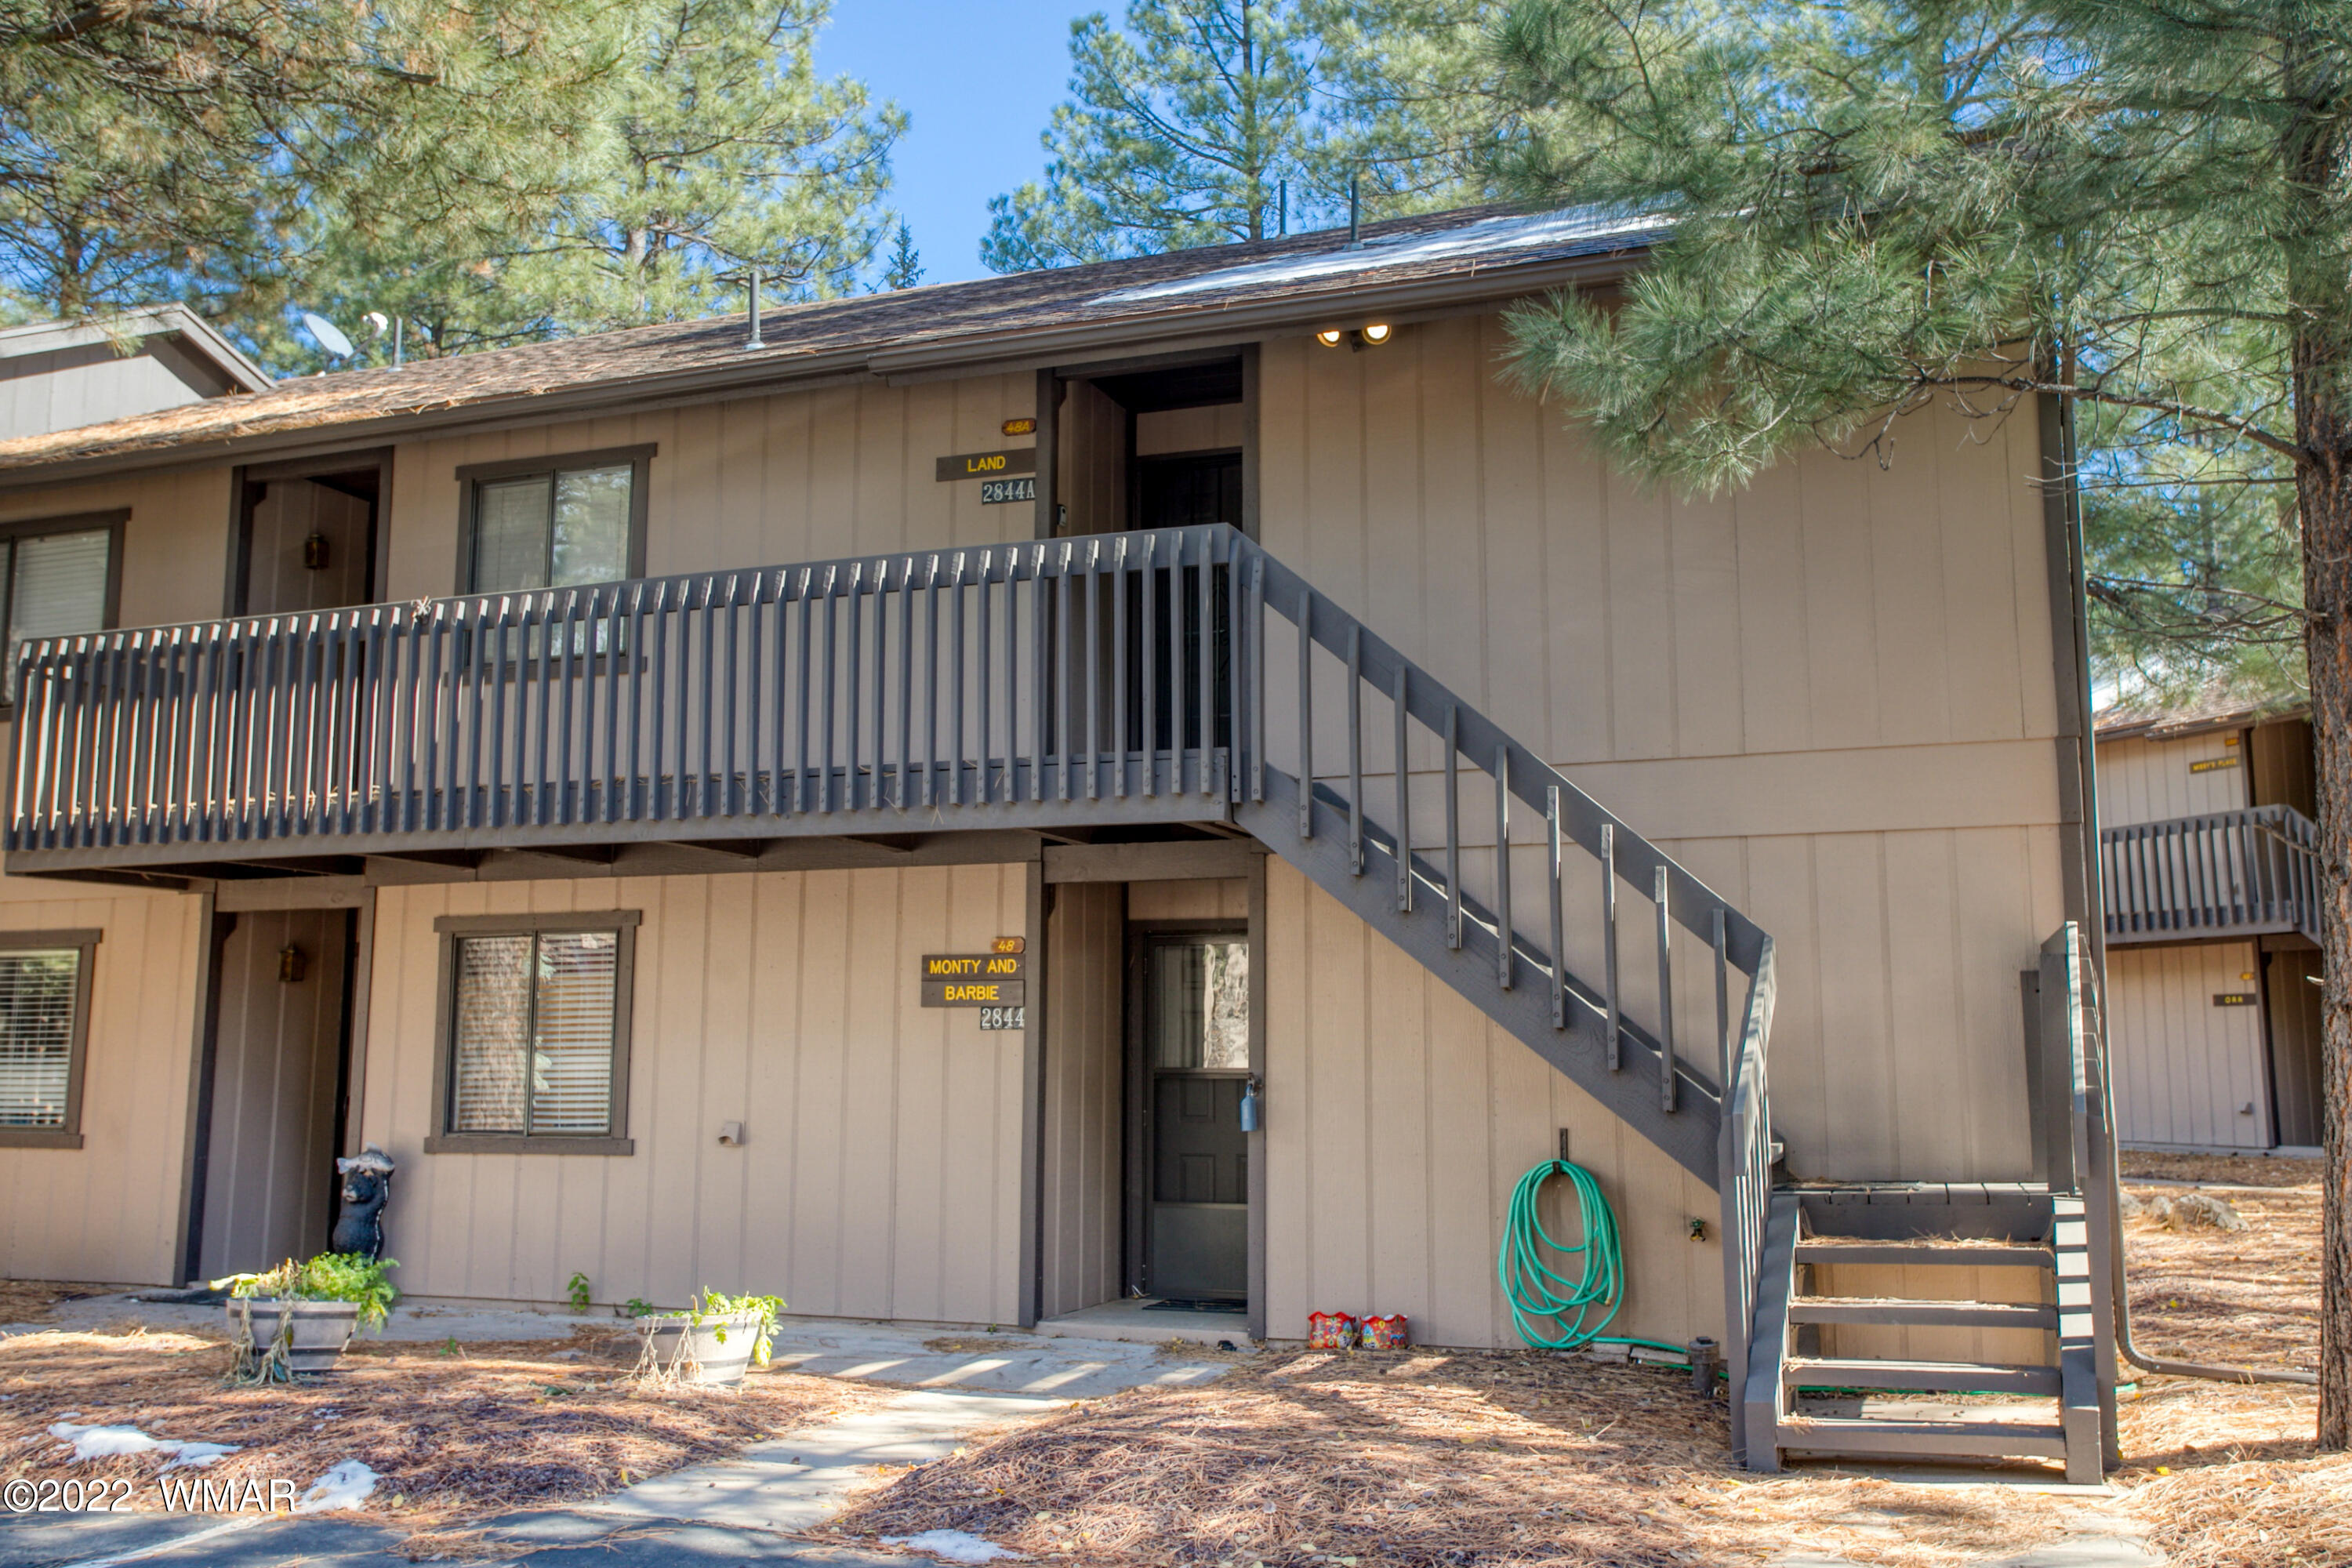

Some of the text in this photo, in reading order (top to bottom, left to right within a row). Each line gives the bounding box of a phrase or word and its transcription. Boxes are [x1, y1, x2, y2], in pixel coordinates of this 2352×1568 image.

[1006, 420, 1030, 433] 48A
[967, 456, 1007, 472] LAND
[983, 480, 1035, 502] 2844A
[998, 940, 1014, 952] 48
[929, 959, 1017, 975] MONTY AND
[945, 985, 1000, 1000] BARBIE
[982, 1007, 1025, 1028] 2844
